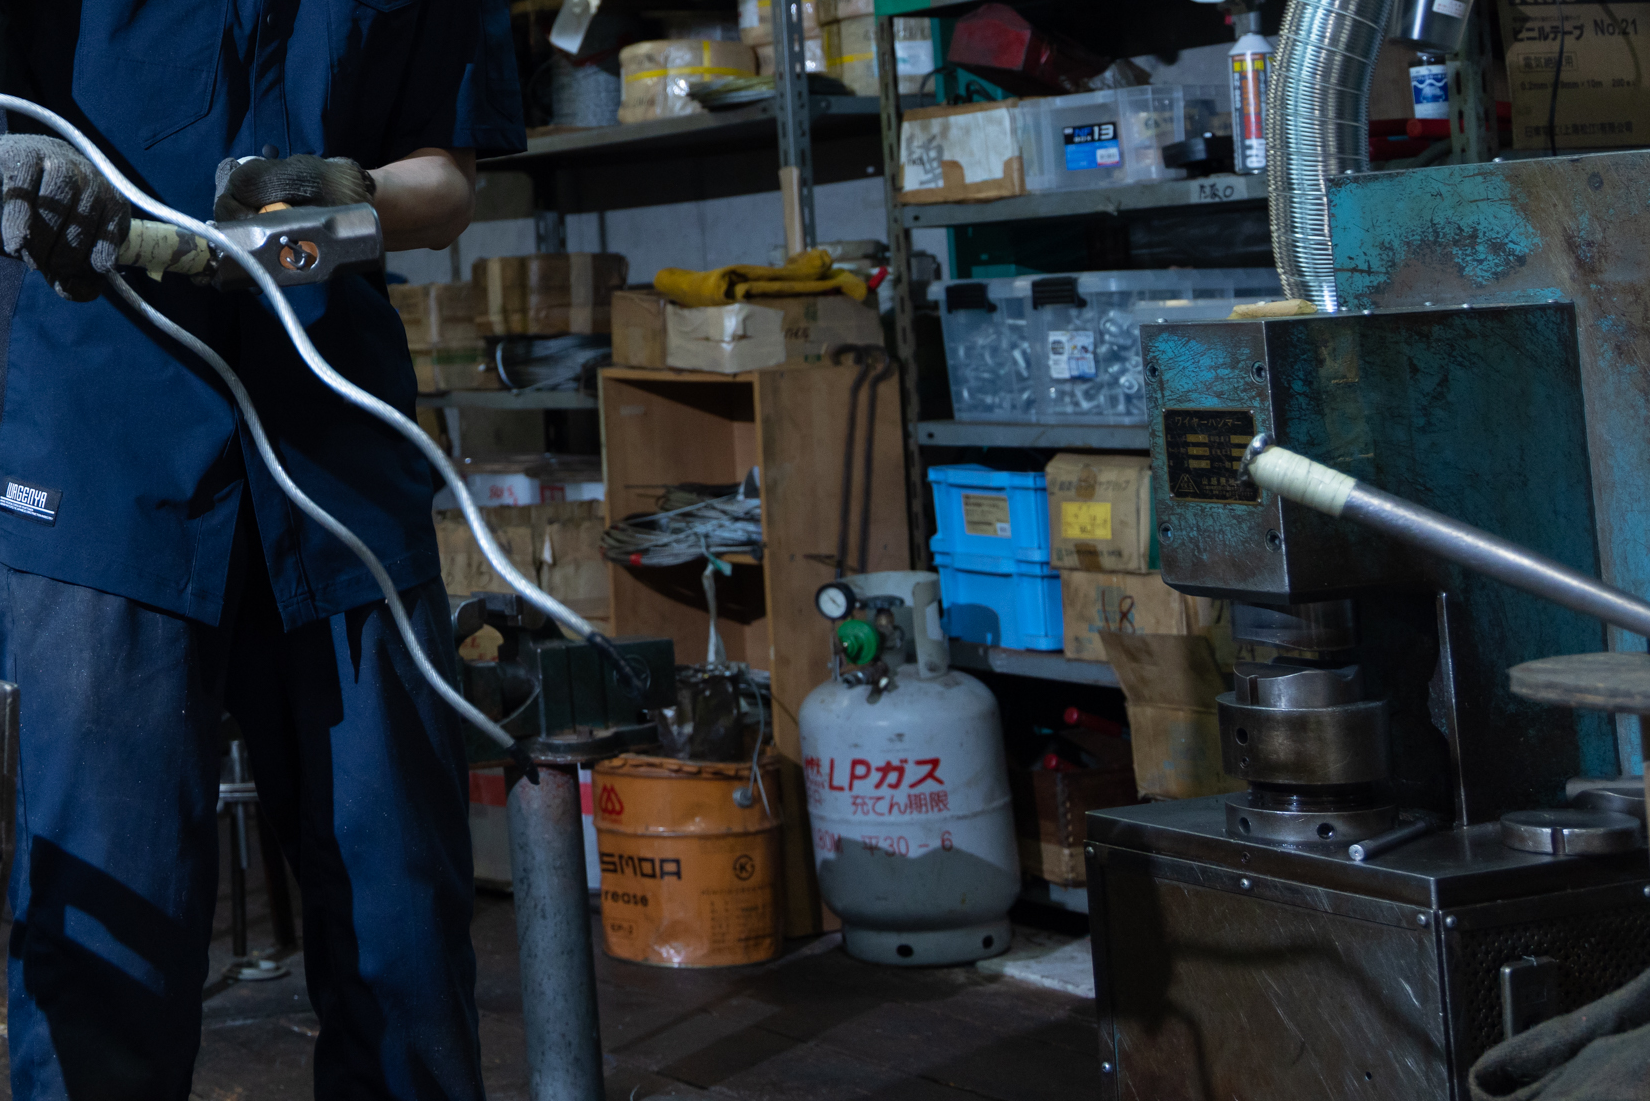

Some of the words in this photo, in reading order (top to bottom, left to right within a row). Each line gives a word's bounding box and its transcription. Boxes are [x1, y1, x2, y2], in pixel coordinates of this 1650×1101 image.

[1593, 18, 1638, 36] No.21
[1093, 124, 1114, 141] 13
[1175, 417, 1242, 428] ワイヤーハンマー
[829, 758, 945, 791] LPガス
[851, 790, 950, 817] 充てん期限
